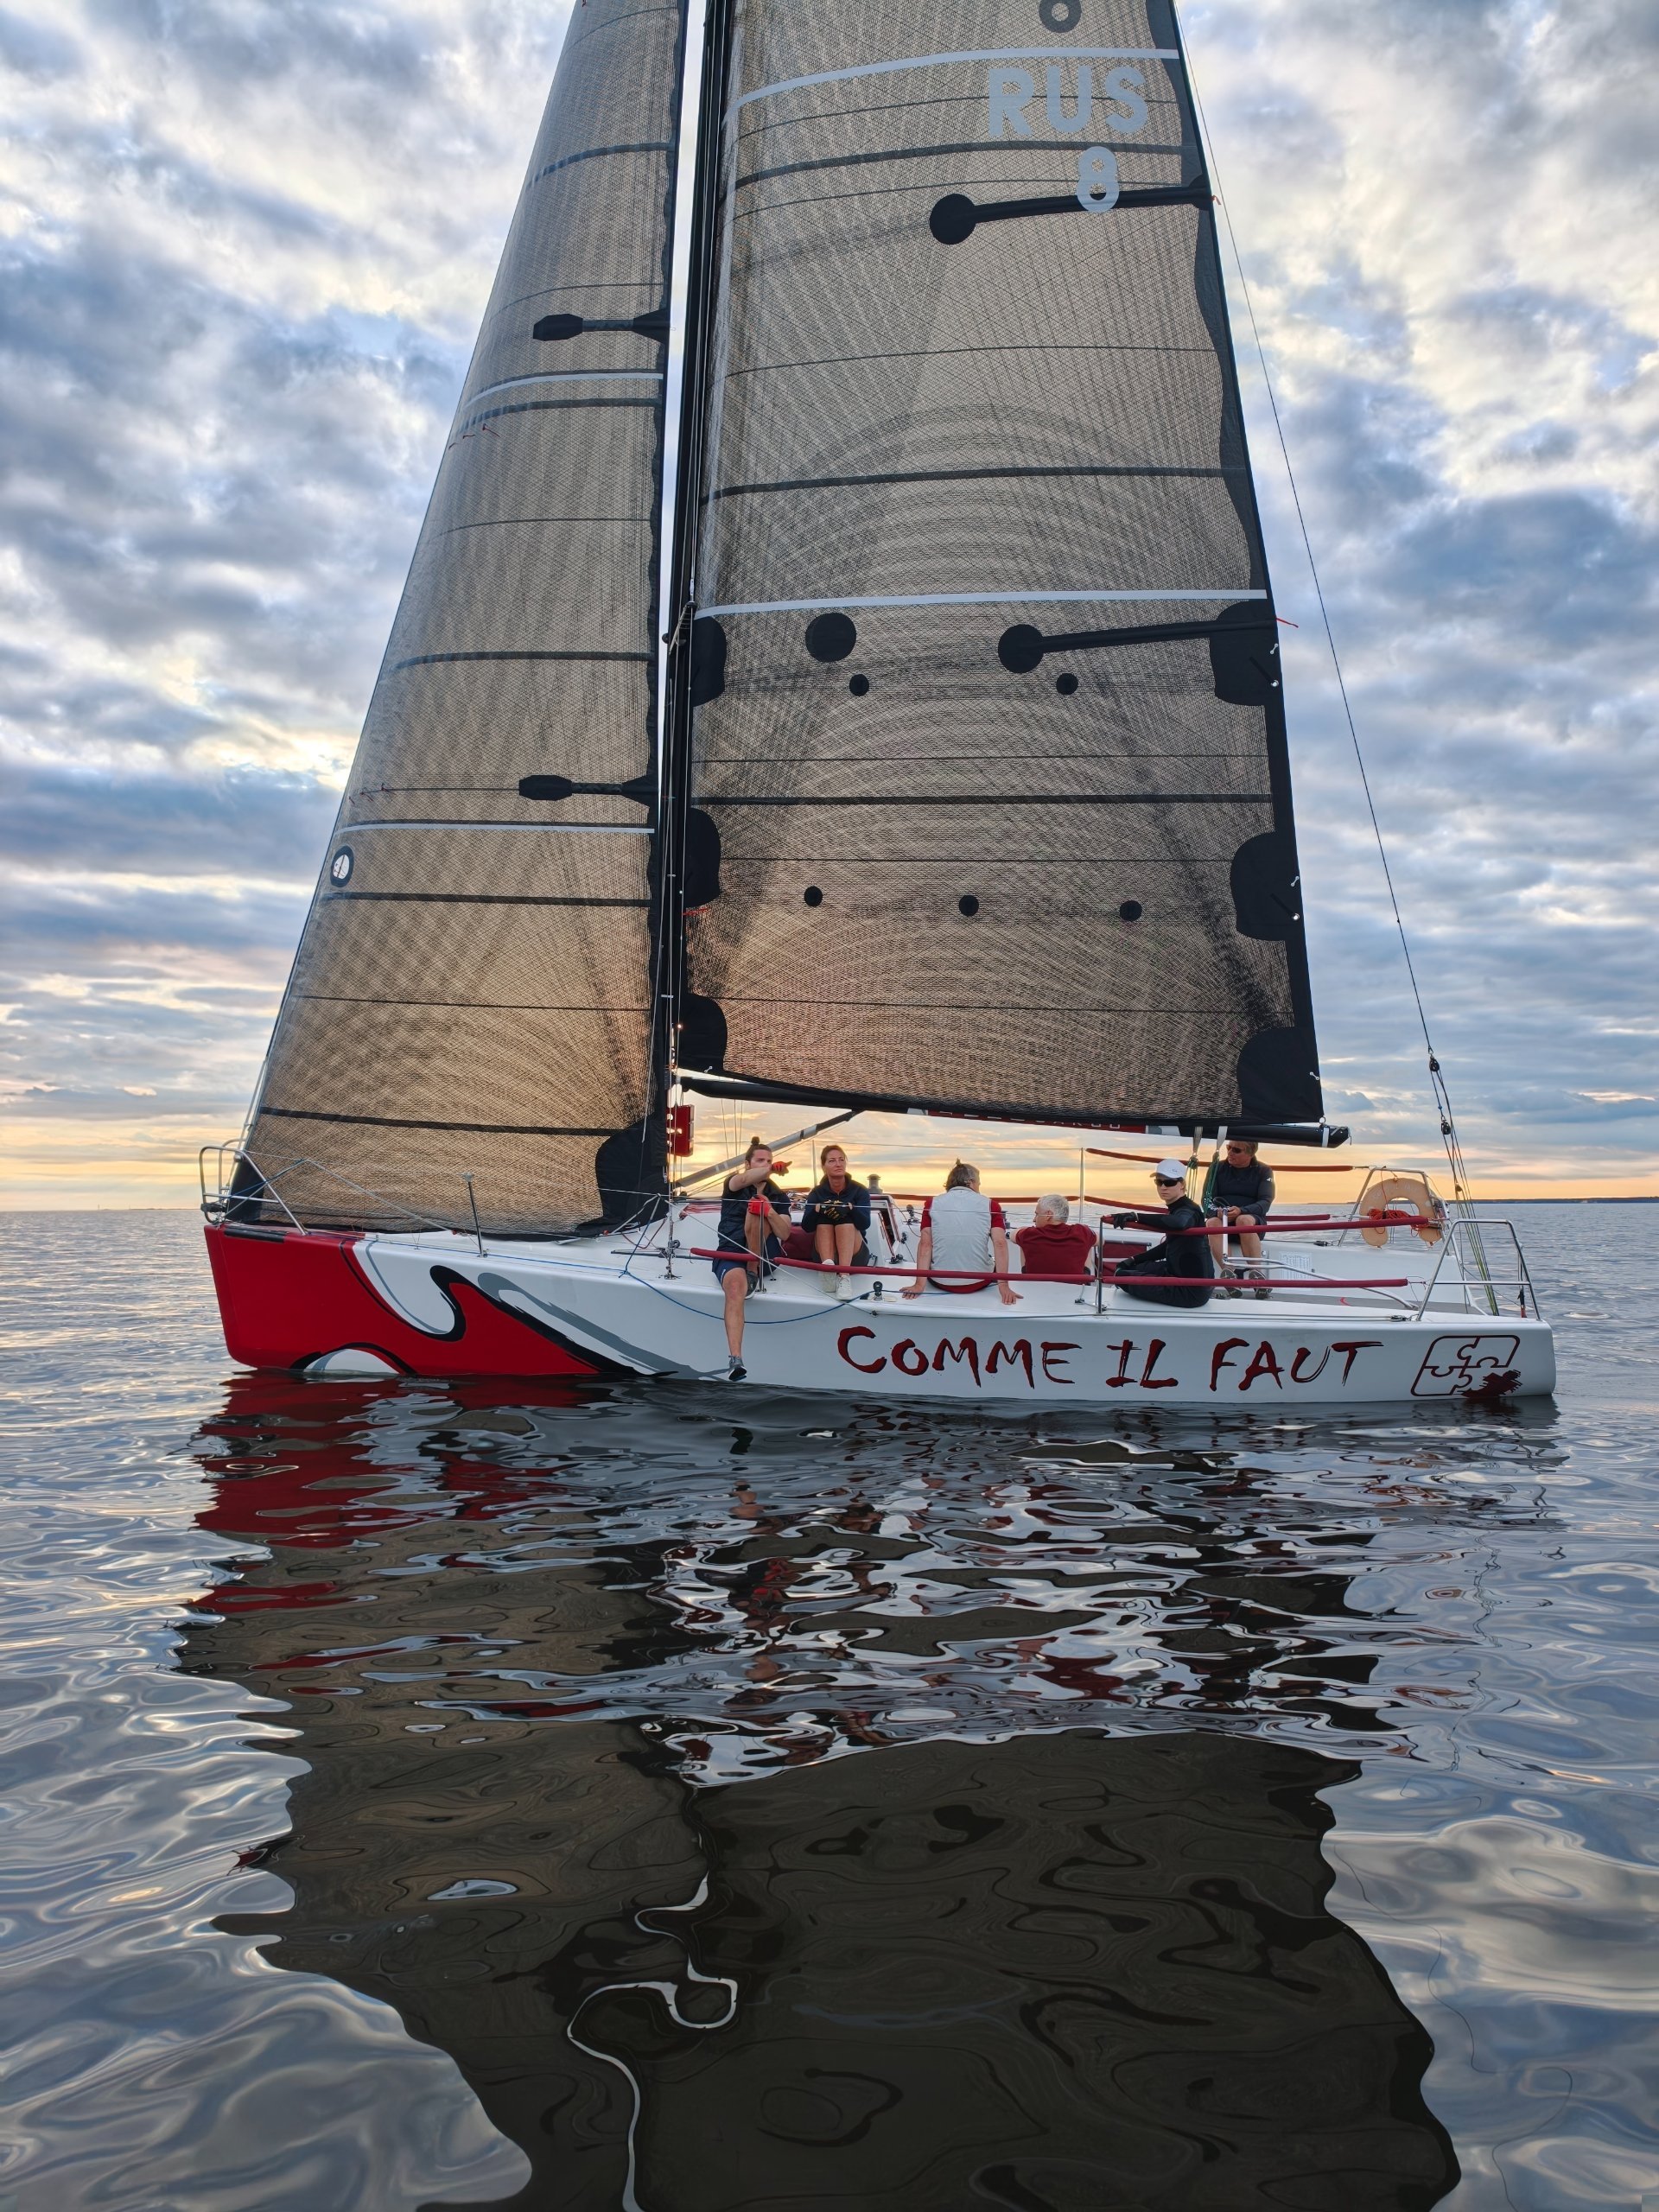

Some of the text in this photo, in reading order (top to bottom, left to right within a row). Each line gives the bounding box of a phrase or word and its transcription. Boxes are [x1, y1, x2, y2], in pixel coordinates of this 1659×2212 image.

[988, 66, 1148, 137] RUS
[1077, 146, 1119, 213] 8
[837, 1326, 1384, 1391] COMME IL FAUT
